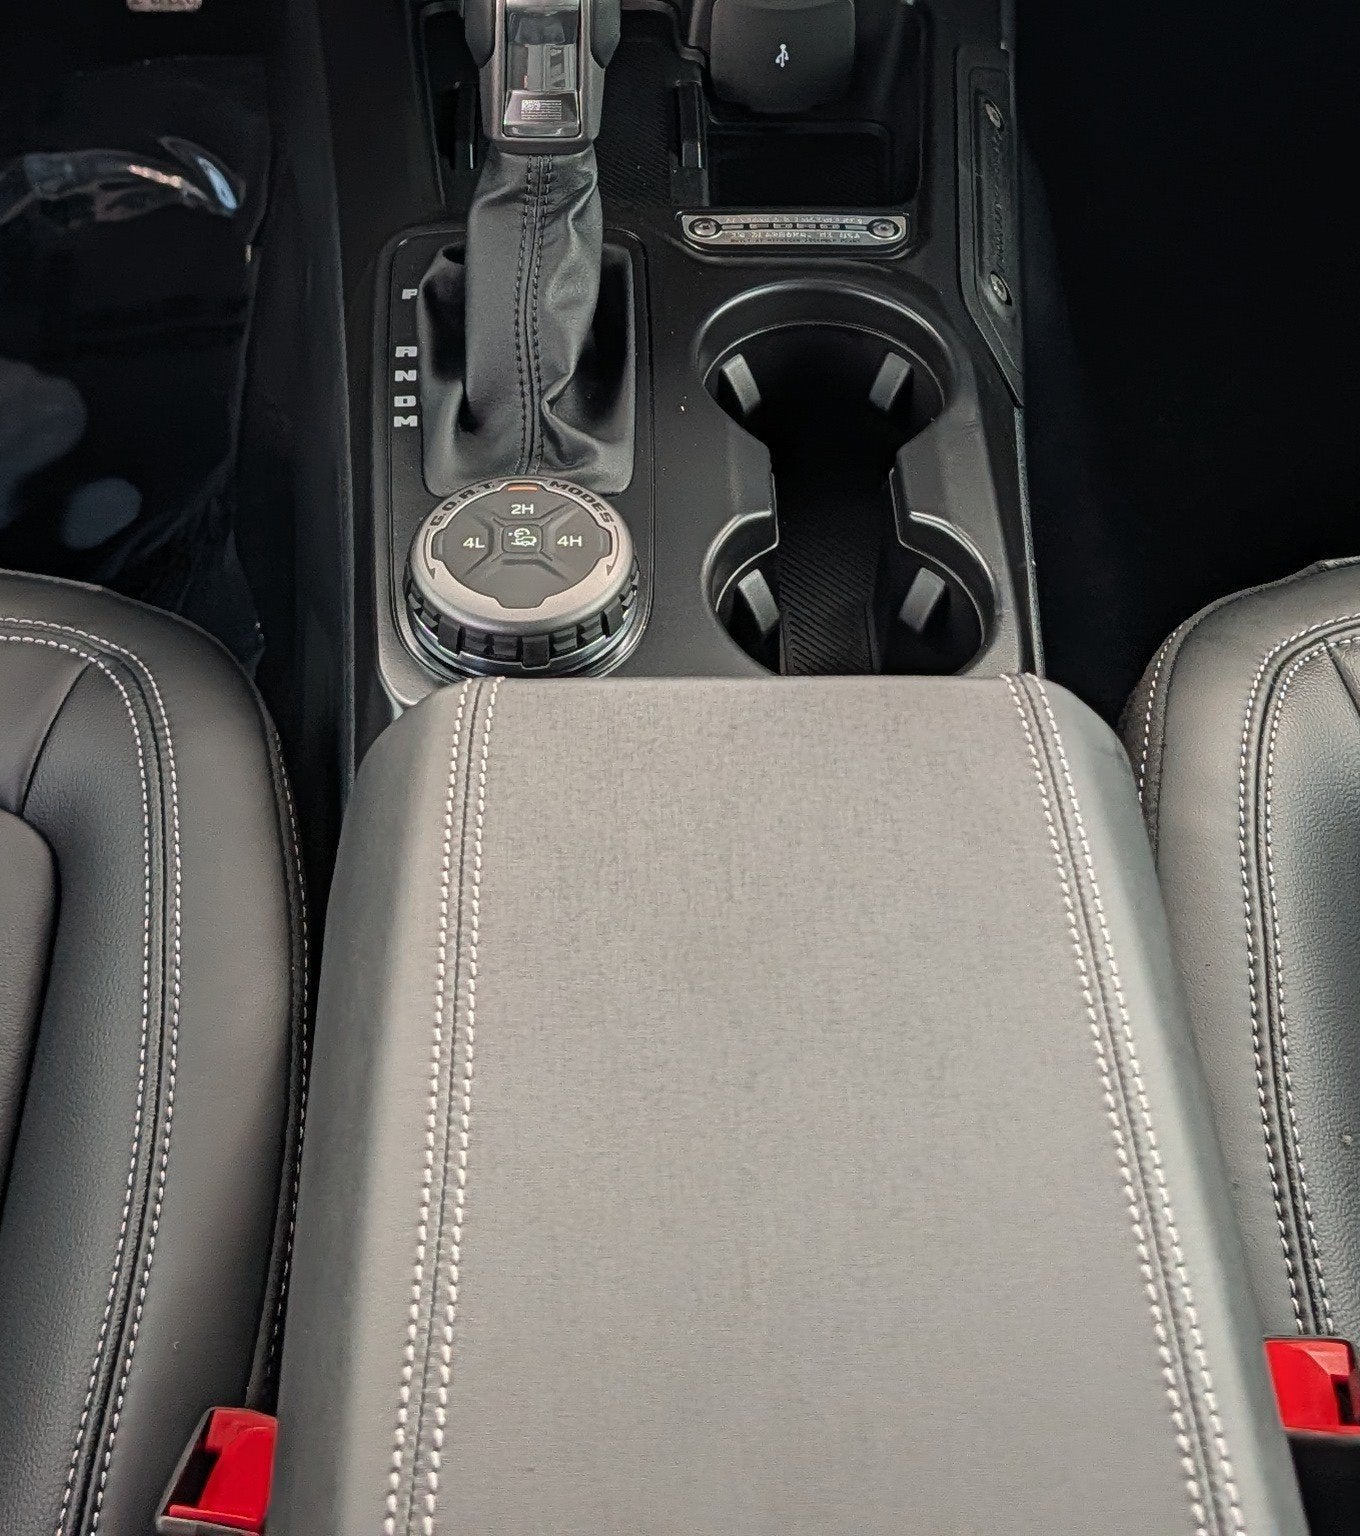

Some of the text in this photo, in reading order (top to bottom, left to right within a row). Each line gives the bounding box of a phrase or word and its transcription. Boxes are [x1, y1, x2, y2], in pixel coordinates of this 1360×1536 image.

[402, 289, 418, 300] P
[395, 369, 417, 382] N
[394, 395, 417, 407] D
[393, 415, 418, 427] M
[549, 481, 614, 524] MODES
[510, 503, 534, 515] 2H
[462, 537, 486, 549] 4L
[557, 535, 583, 547] 4H
